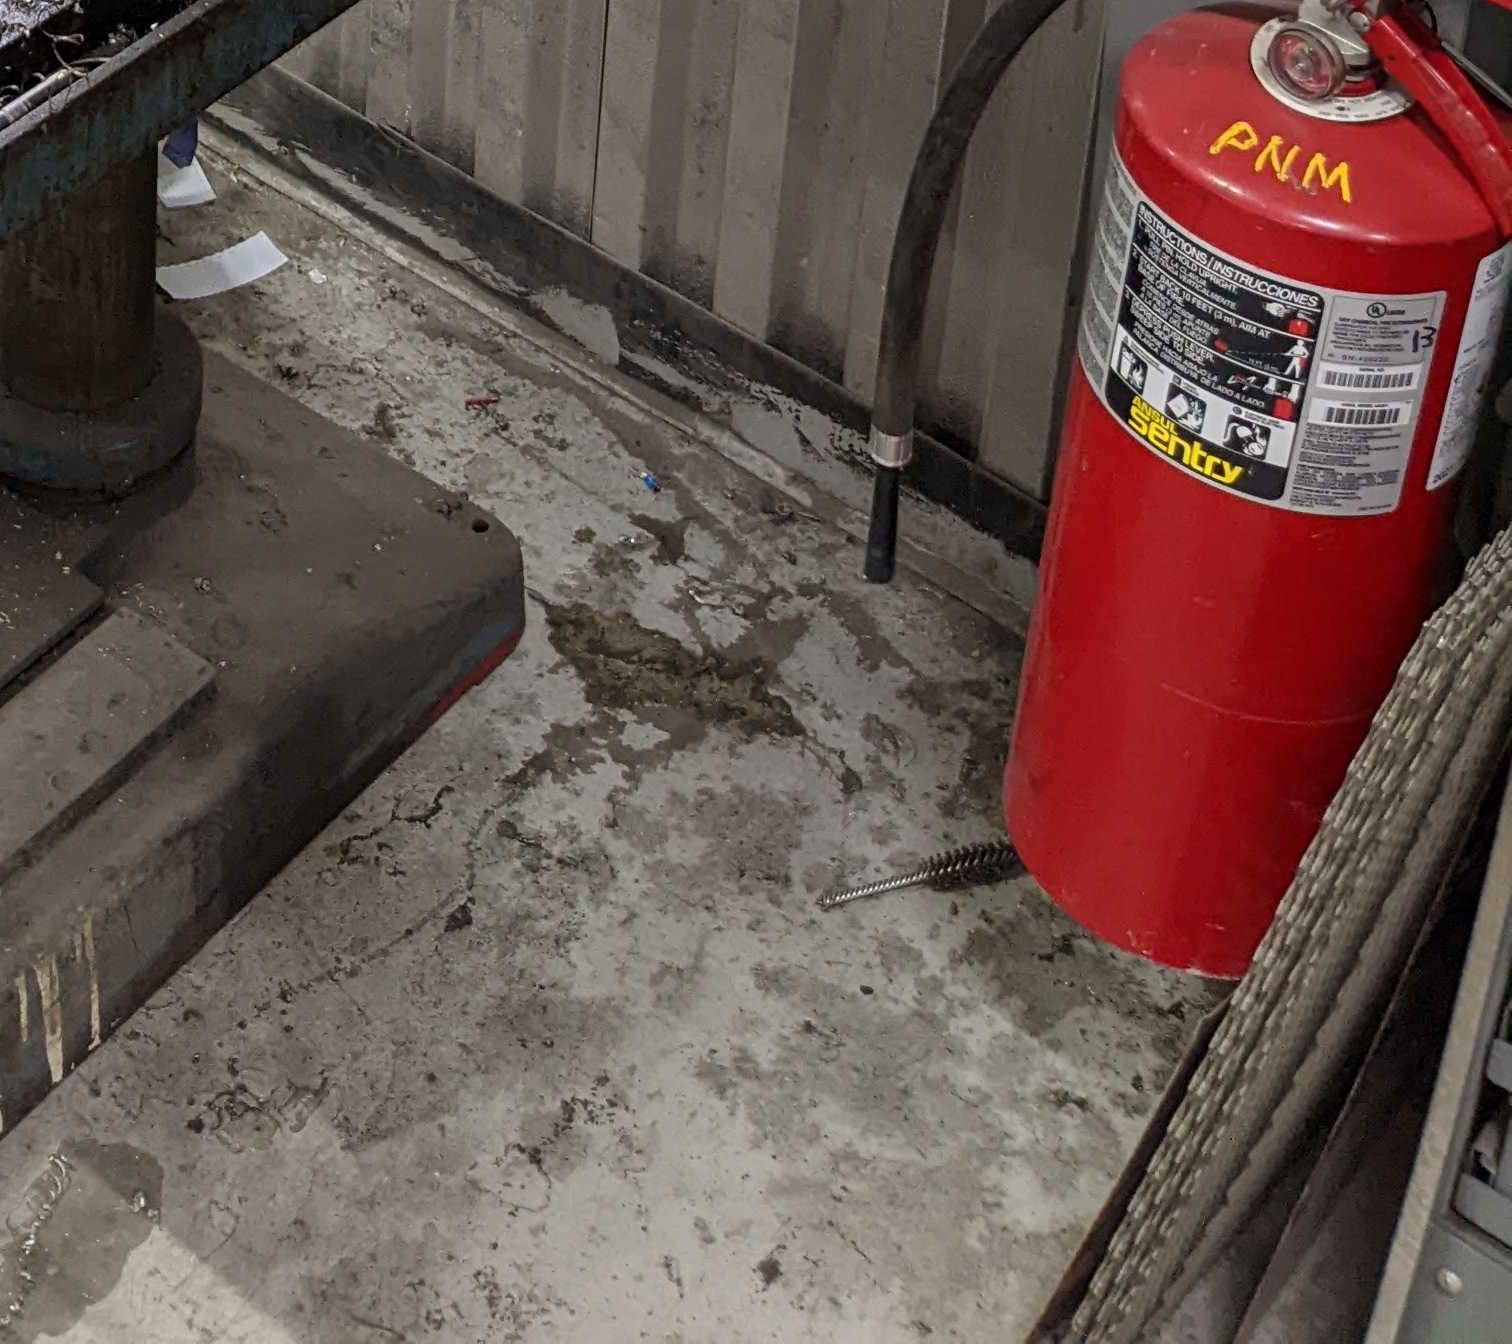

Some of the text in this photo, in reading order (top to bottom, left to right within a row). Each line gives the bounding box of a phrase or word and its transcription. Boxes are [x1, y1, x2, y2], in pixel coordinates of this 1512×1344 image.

[1208, 121, 1352, 203] PNM
[1412, 326, 1437, 353] 13
[1132, 395, 1179, 436] ANSUL
